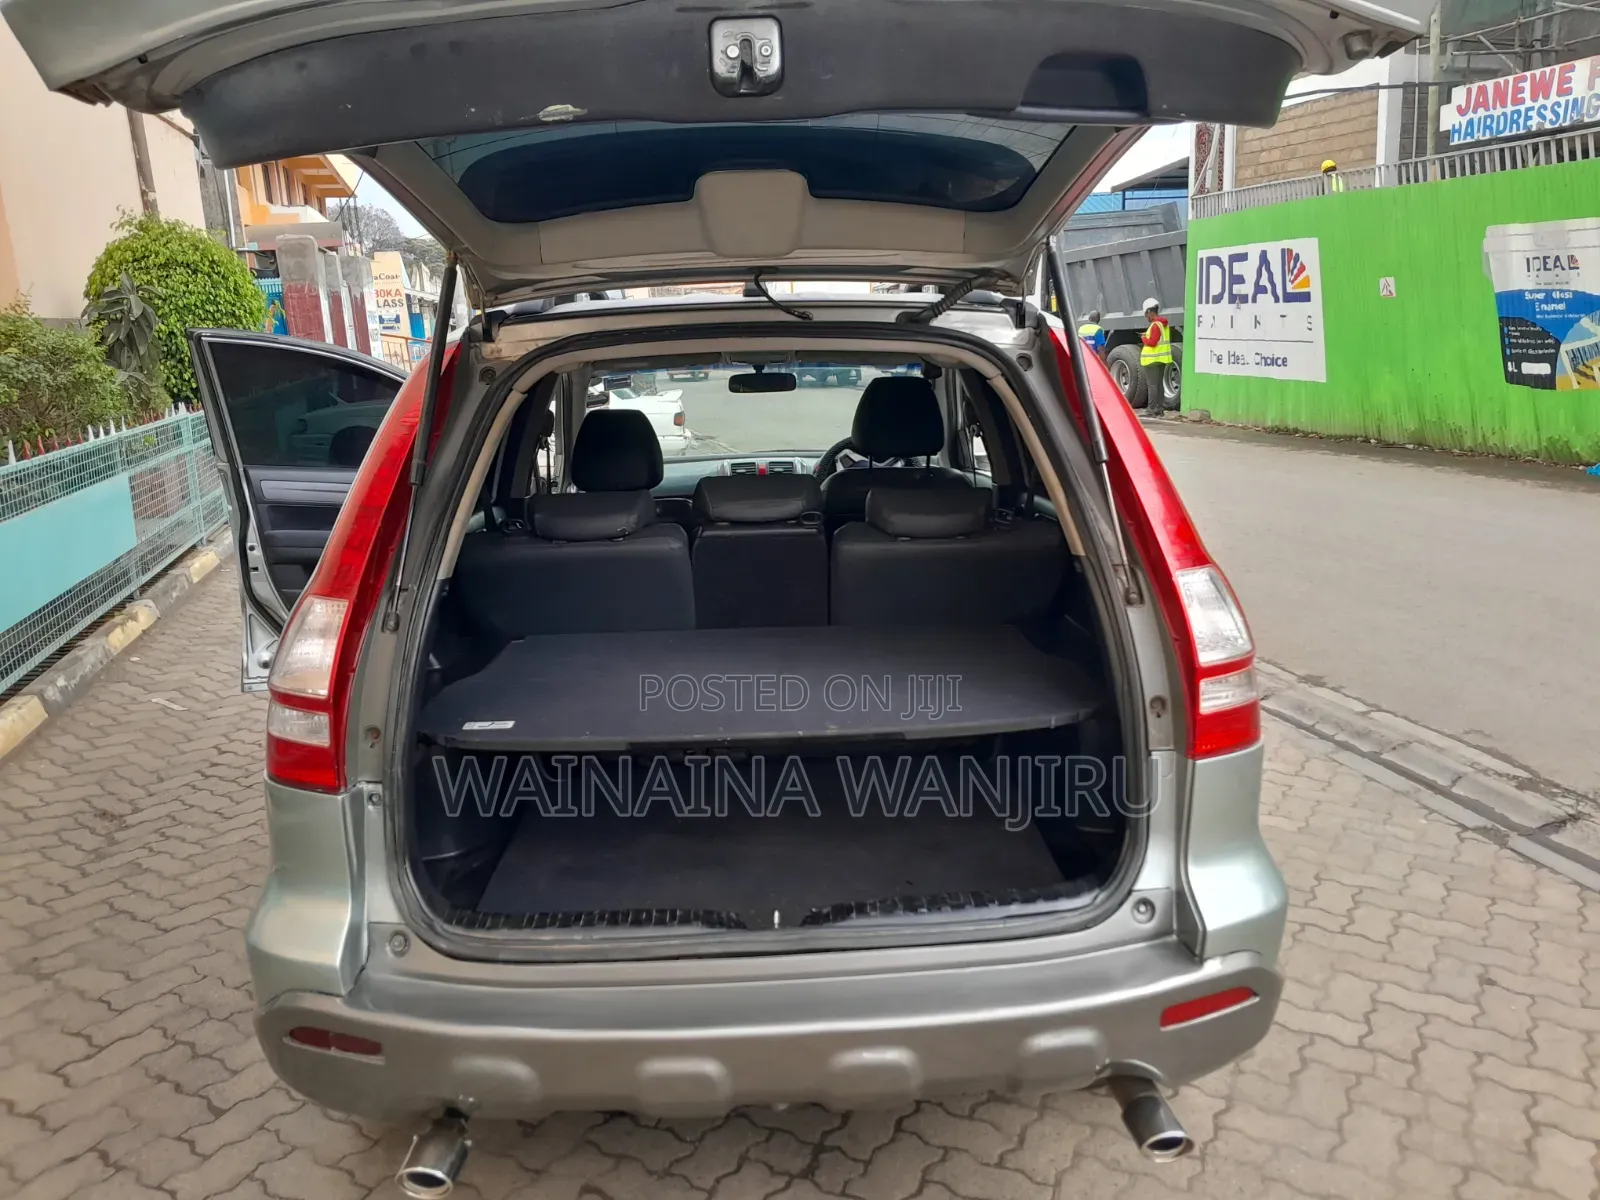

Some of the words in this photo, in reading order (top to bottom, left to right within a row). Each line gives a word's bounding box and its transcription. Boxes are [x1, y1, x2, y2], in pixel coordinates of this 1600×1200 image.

[1456, 63, 1576, 117] JANEWE
[1450, 93, 1600, 143] HAIRDRESSING
[1198, 247, 1311, 305] IDEAL
[1526, 254, 1580, 272] IDEAL
[1535, 302, 1566, 311] Enamel
[1254, 352, 1288, 367] Choice
